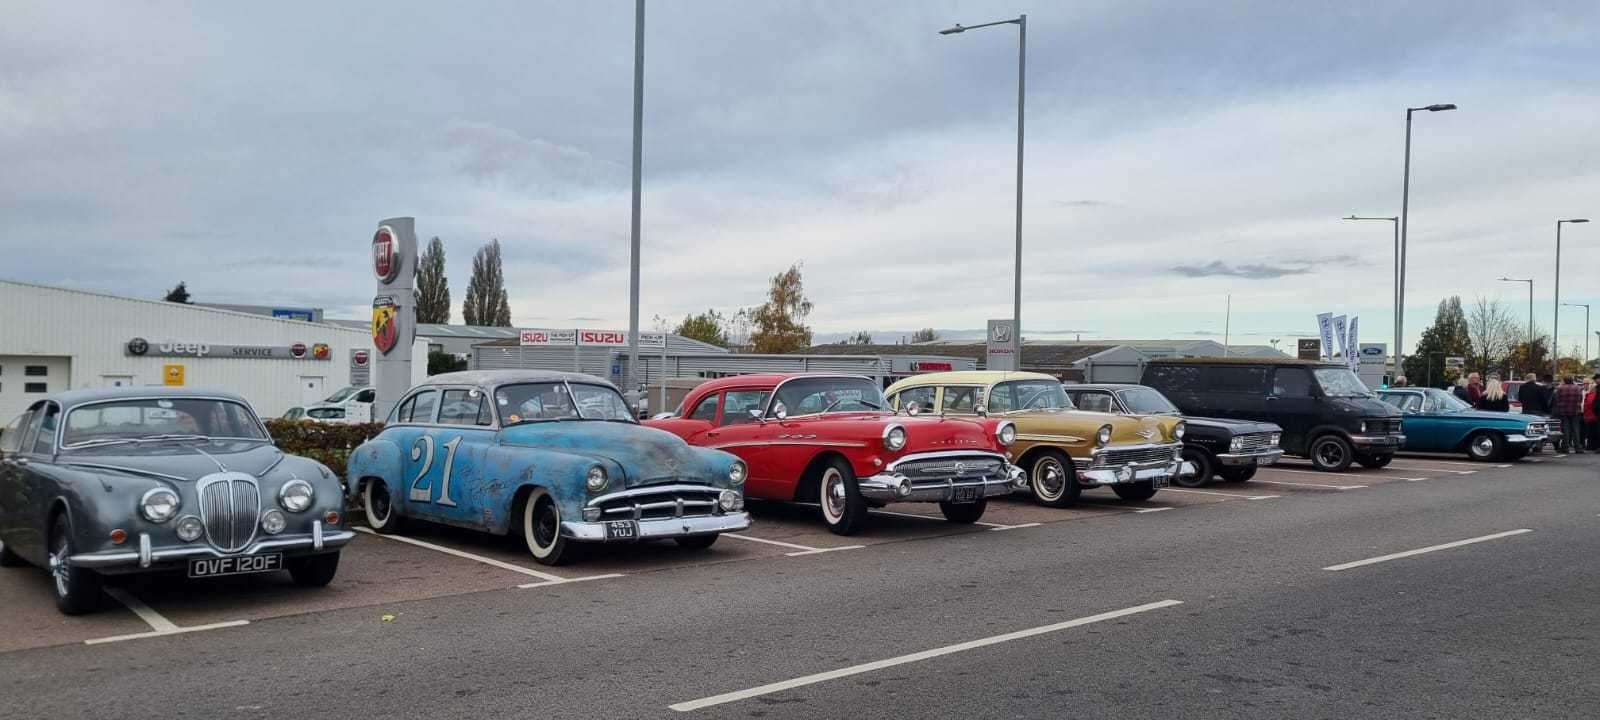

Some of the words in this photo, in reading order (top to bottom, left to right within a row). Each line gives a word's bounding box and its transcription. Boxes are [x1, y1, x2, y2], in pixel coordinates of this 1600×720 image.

[522, 332, 548, 342] ISUZU
[581, 332, 624, 344] ISUZU
[160, 342, 210, 356] Jeep
[232, 347, 272, 357] SERVICE
[409, 435, 464, 507] 21
[612, 528, 633, 537] YUJ
[195, 558, 233, 575] OVF
[236, 555, 277, 572] 120F
